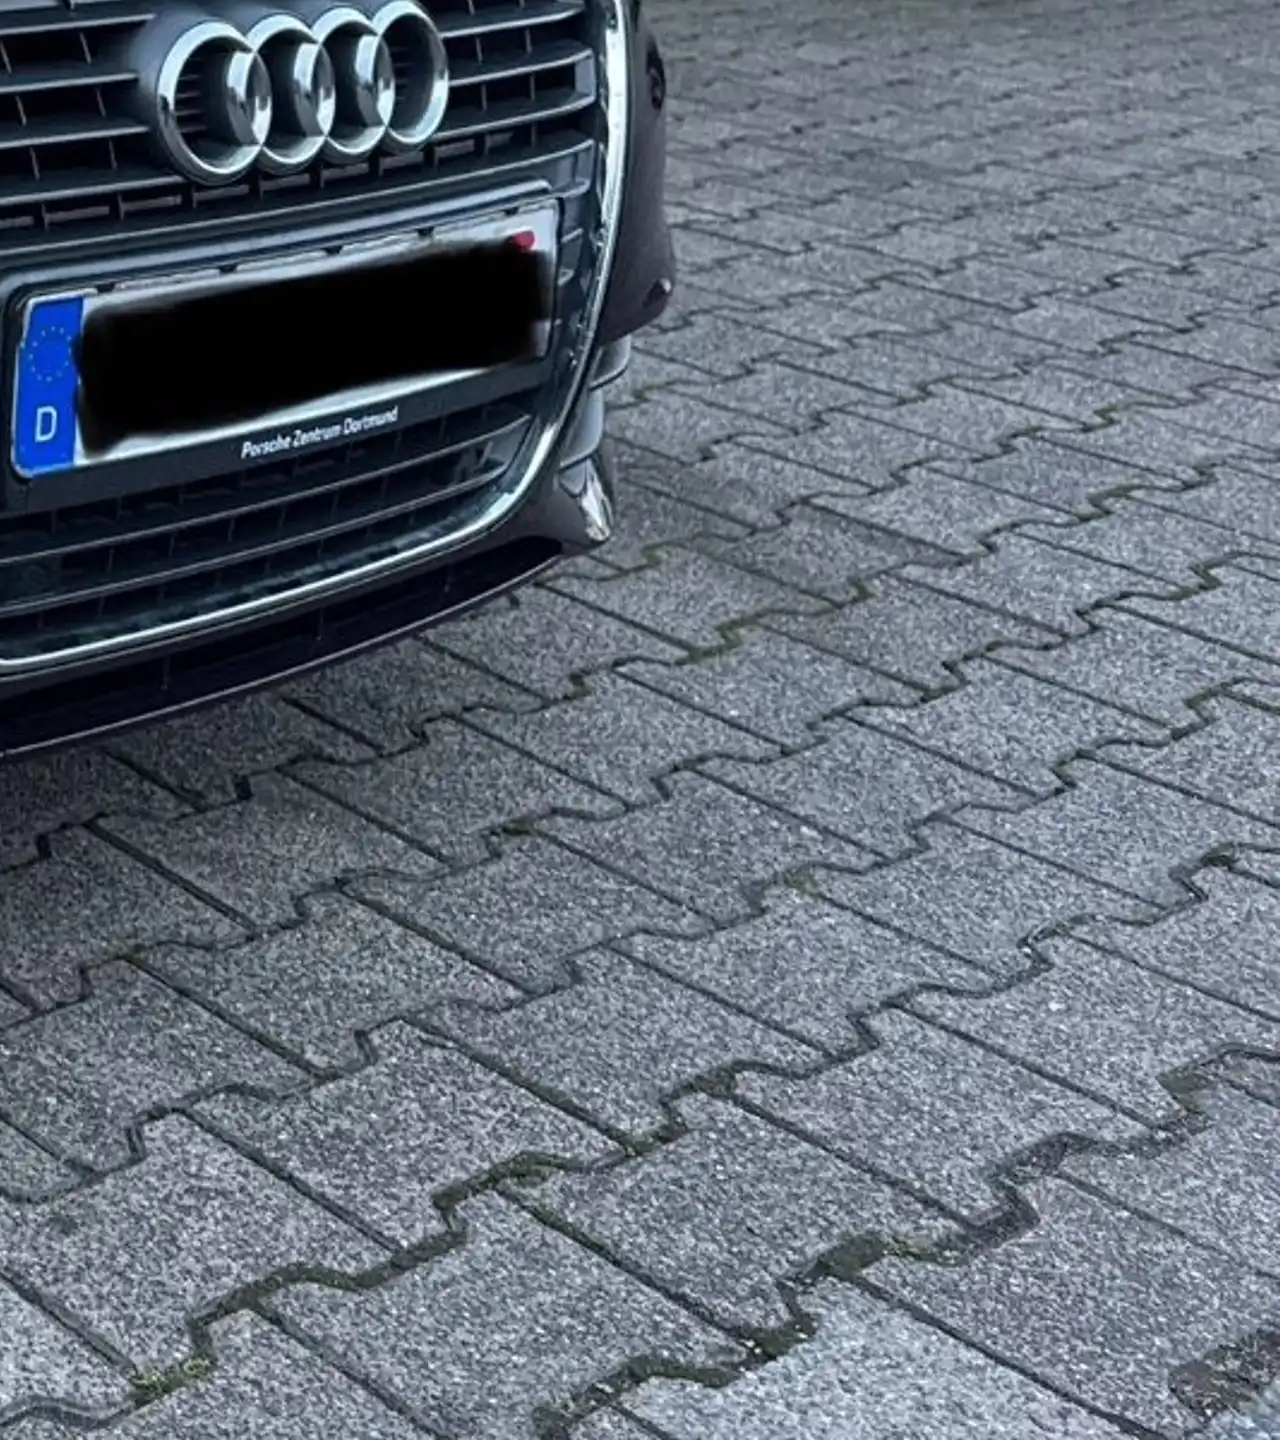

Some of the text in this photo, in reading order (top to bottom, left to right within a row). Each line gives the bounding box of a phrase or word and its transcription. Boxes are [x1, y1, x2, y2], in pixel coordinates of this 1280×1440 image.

[35, 406, 57, 442] D
[241, 405, 399, 459] Porsche Zentrum Dortmund
